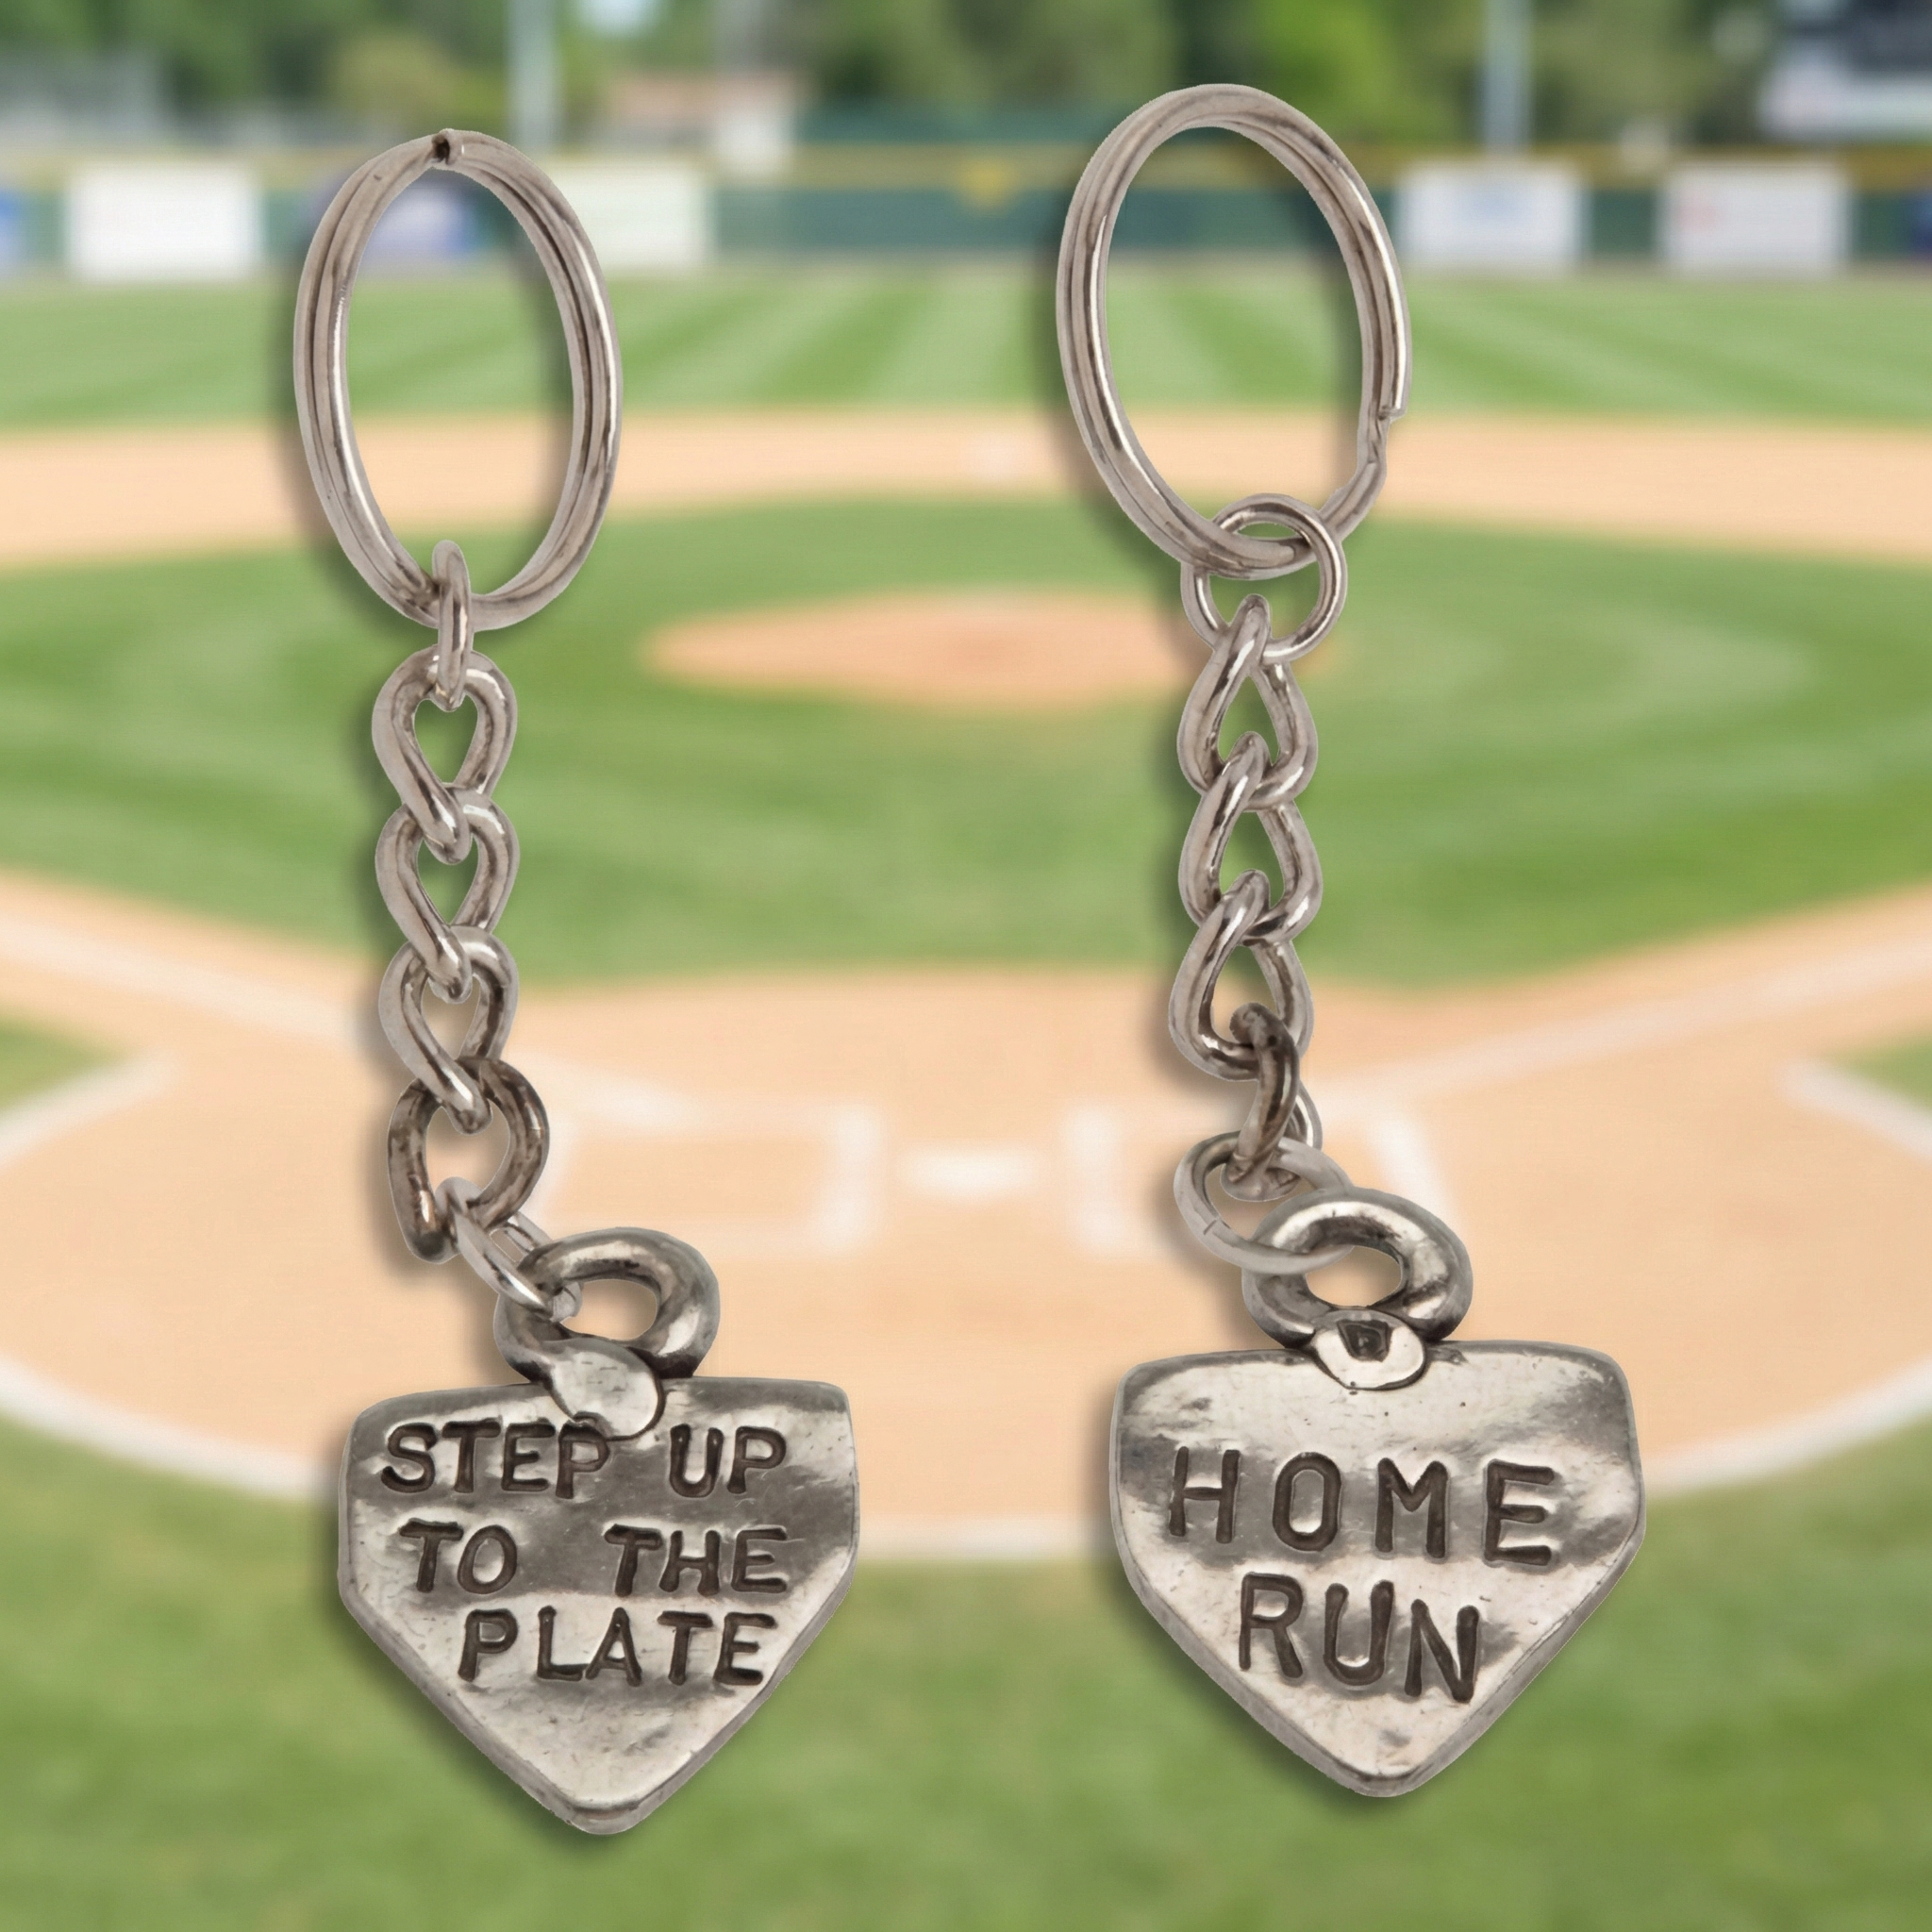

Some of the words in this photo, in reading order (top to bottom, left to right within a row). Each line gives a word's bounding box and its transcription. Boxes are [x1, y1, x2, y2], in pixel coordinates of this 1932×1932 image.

[381, 1418, 610, 1498] STEP
[669, 1424, 787, 1497] UP
[1169, 1446, 1556, 1565] HOME
[399, 1518, 518, 1594] TO
[604, 1524, 788, 1596] THE
[458, 1606, 777, 1687] PLATE
[1239, 1572, 1480, 1703] RUN
